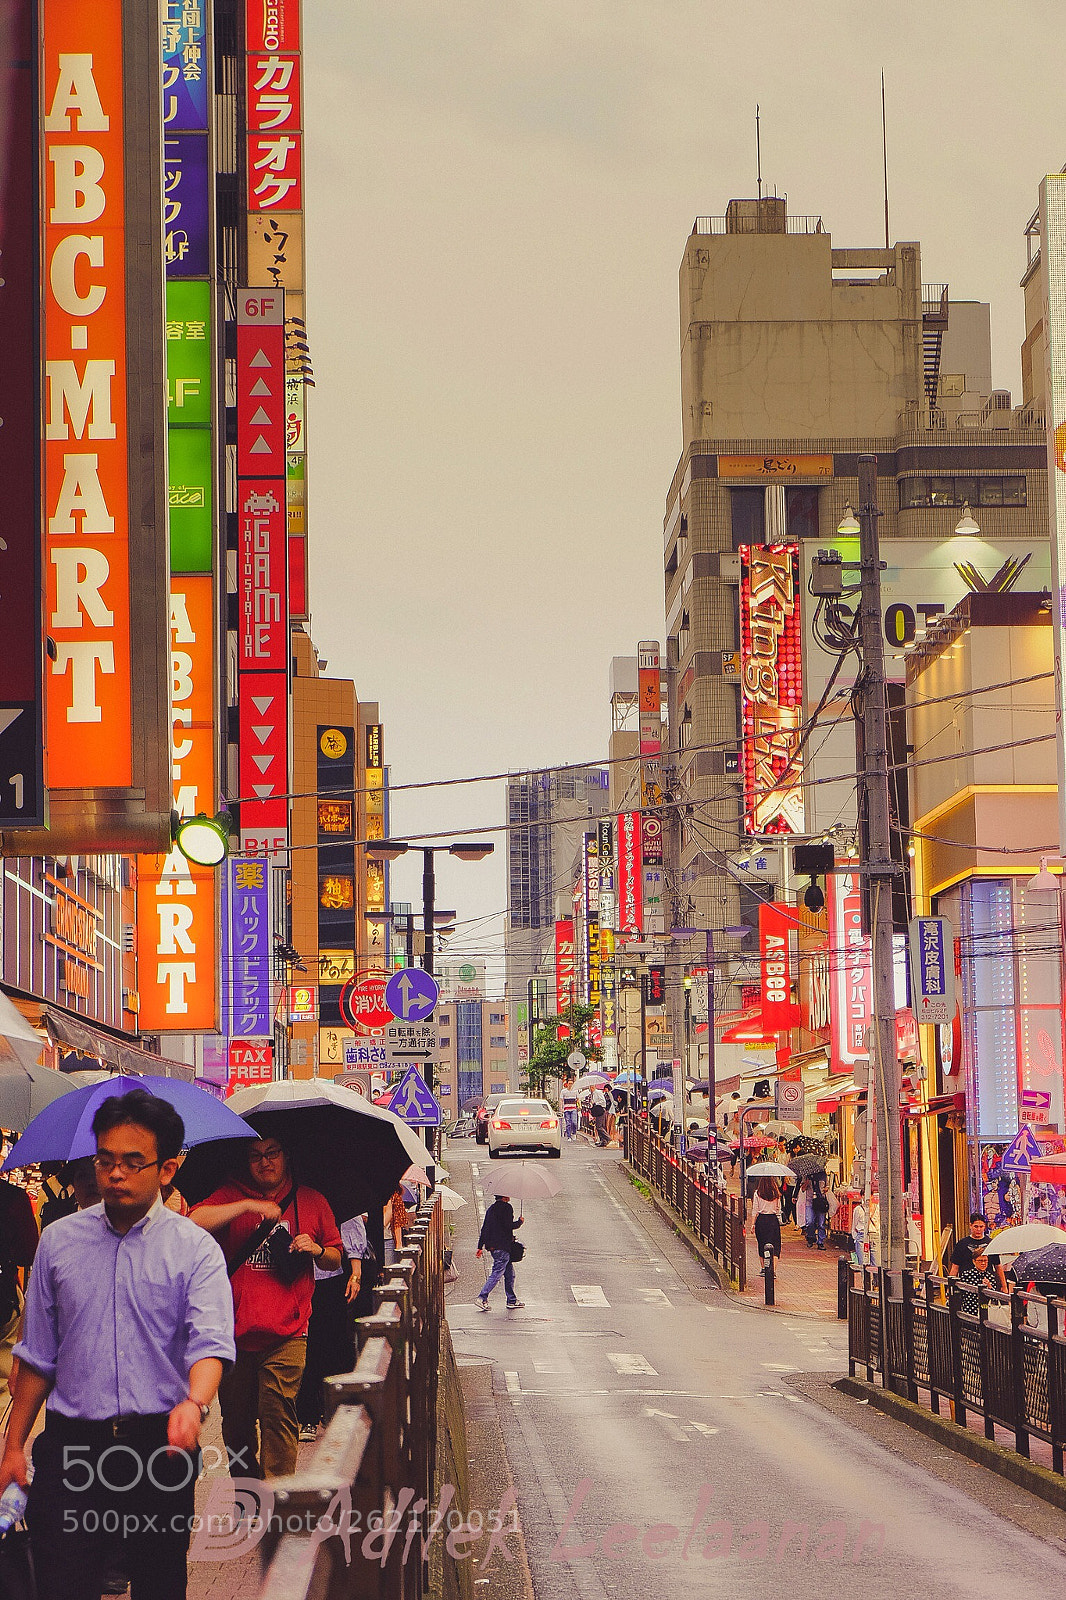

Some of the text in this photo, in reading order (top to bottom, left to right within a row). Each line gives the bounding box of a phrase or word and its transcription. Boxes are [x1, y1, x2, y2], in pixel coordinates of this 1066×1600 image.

[264, 8, 279, 51] ECHO
[253, 56, 297, 208] カラオケ
[244, 298, 275, 317] 6F
[244, 519, 253, 658] TAITO STATION
[253, 519, 281, 658] GAME
[244, 838, 285, 858] B1F
[235, 862, 266, 1034] 薬 ハックドラッグ
[388, 1026, 436, 1038] 自転車を除く
[388, 1038, 436, 1048] 一方通行路
[231, 1049, 267, 1063] TAX
[228, 1065, 271, 1079] FREE
